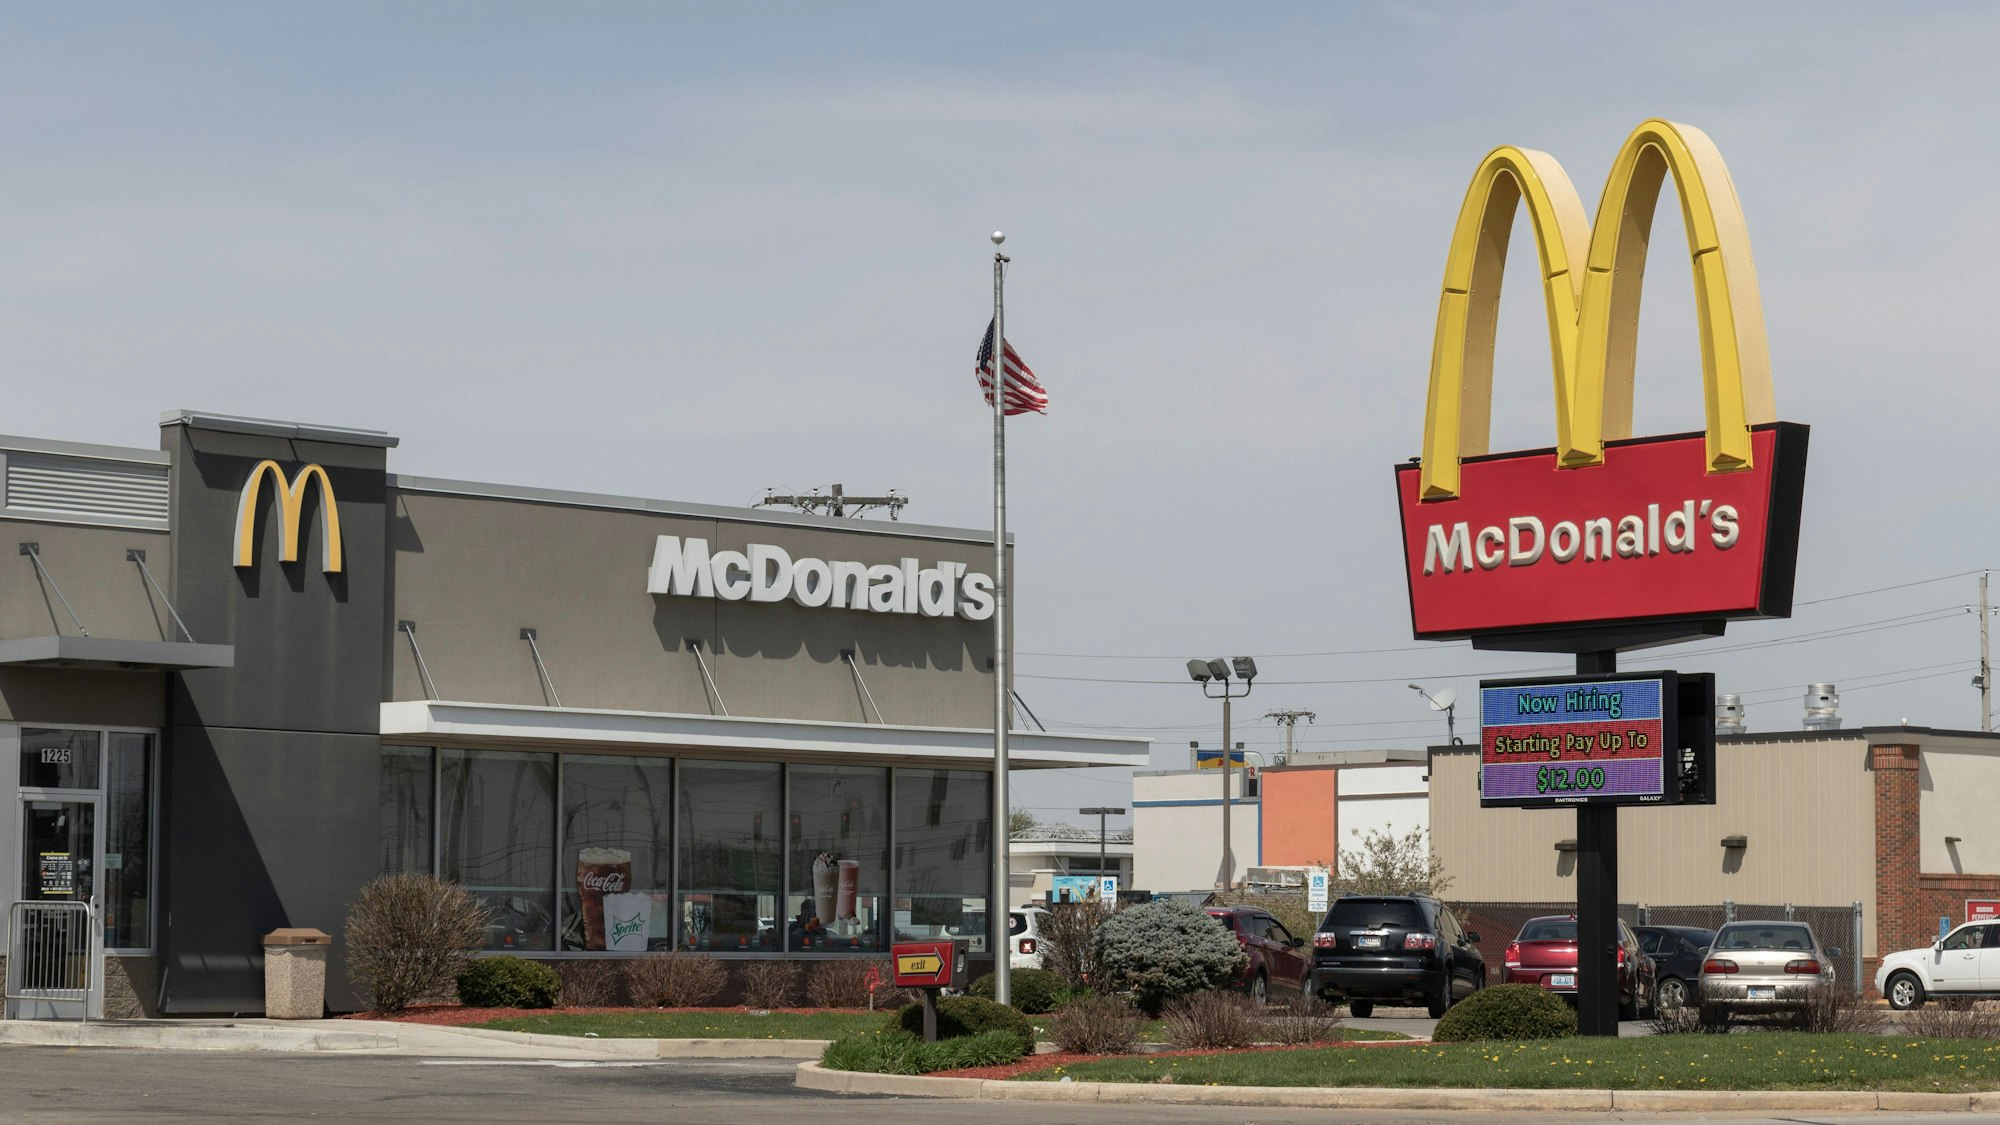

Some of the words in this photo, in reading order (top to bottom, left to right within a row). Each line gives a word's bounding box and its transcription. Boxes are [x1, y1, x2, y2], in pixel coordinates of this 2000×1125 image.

[1422, 499, 1740, 575] McDonald's
[647, 535, 995, 620] McDonald's
[1518, 693, 1558, 714] Now
[1565, 687, 1622, 719] Hiring
[43, 749, 69, 763] 1225
[1495, 733, 1561, 758] Starting
[1565, 733, 1595, 753] Pay
[1599, 732, 1622, 752] Up
[1627, 731, 1648, 749] To
[1537, 765, 1605, 794] $12.00
[584, 871, 625, 892] Coca-Cola
[612, 921, 642, 936] Sprite
[1971, 913, 1999, 921] PEPPERO
[911, 959, 926, 971] exit
